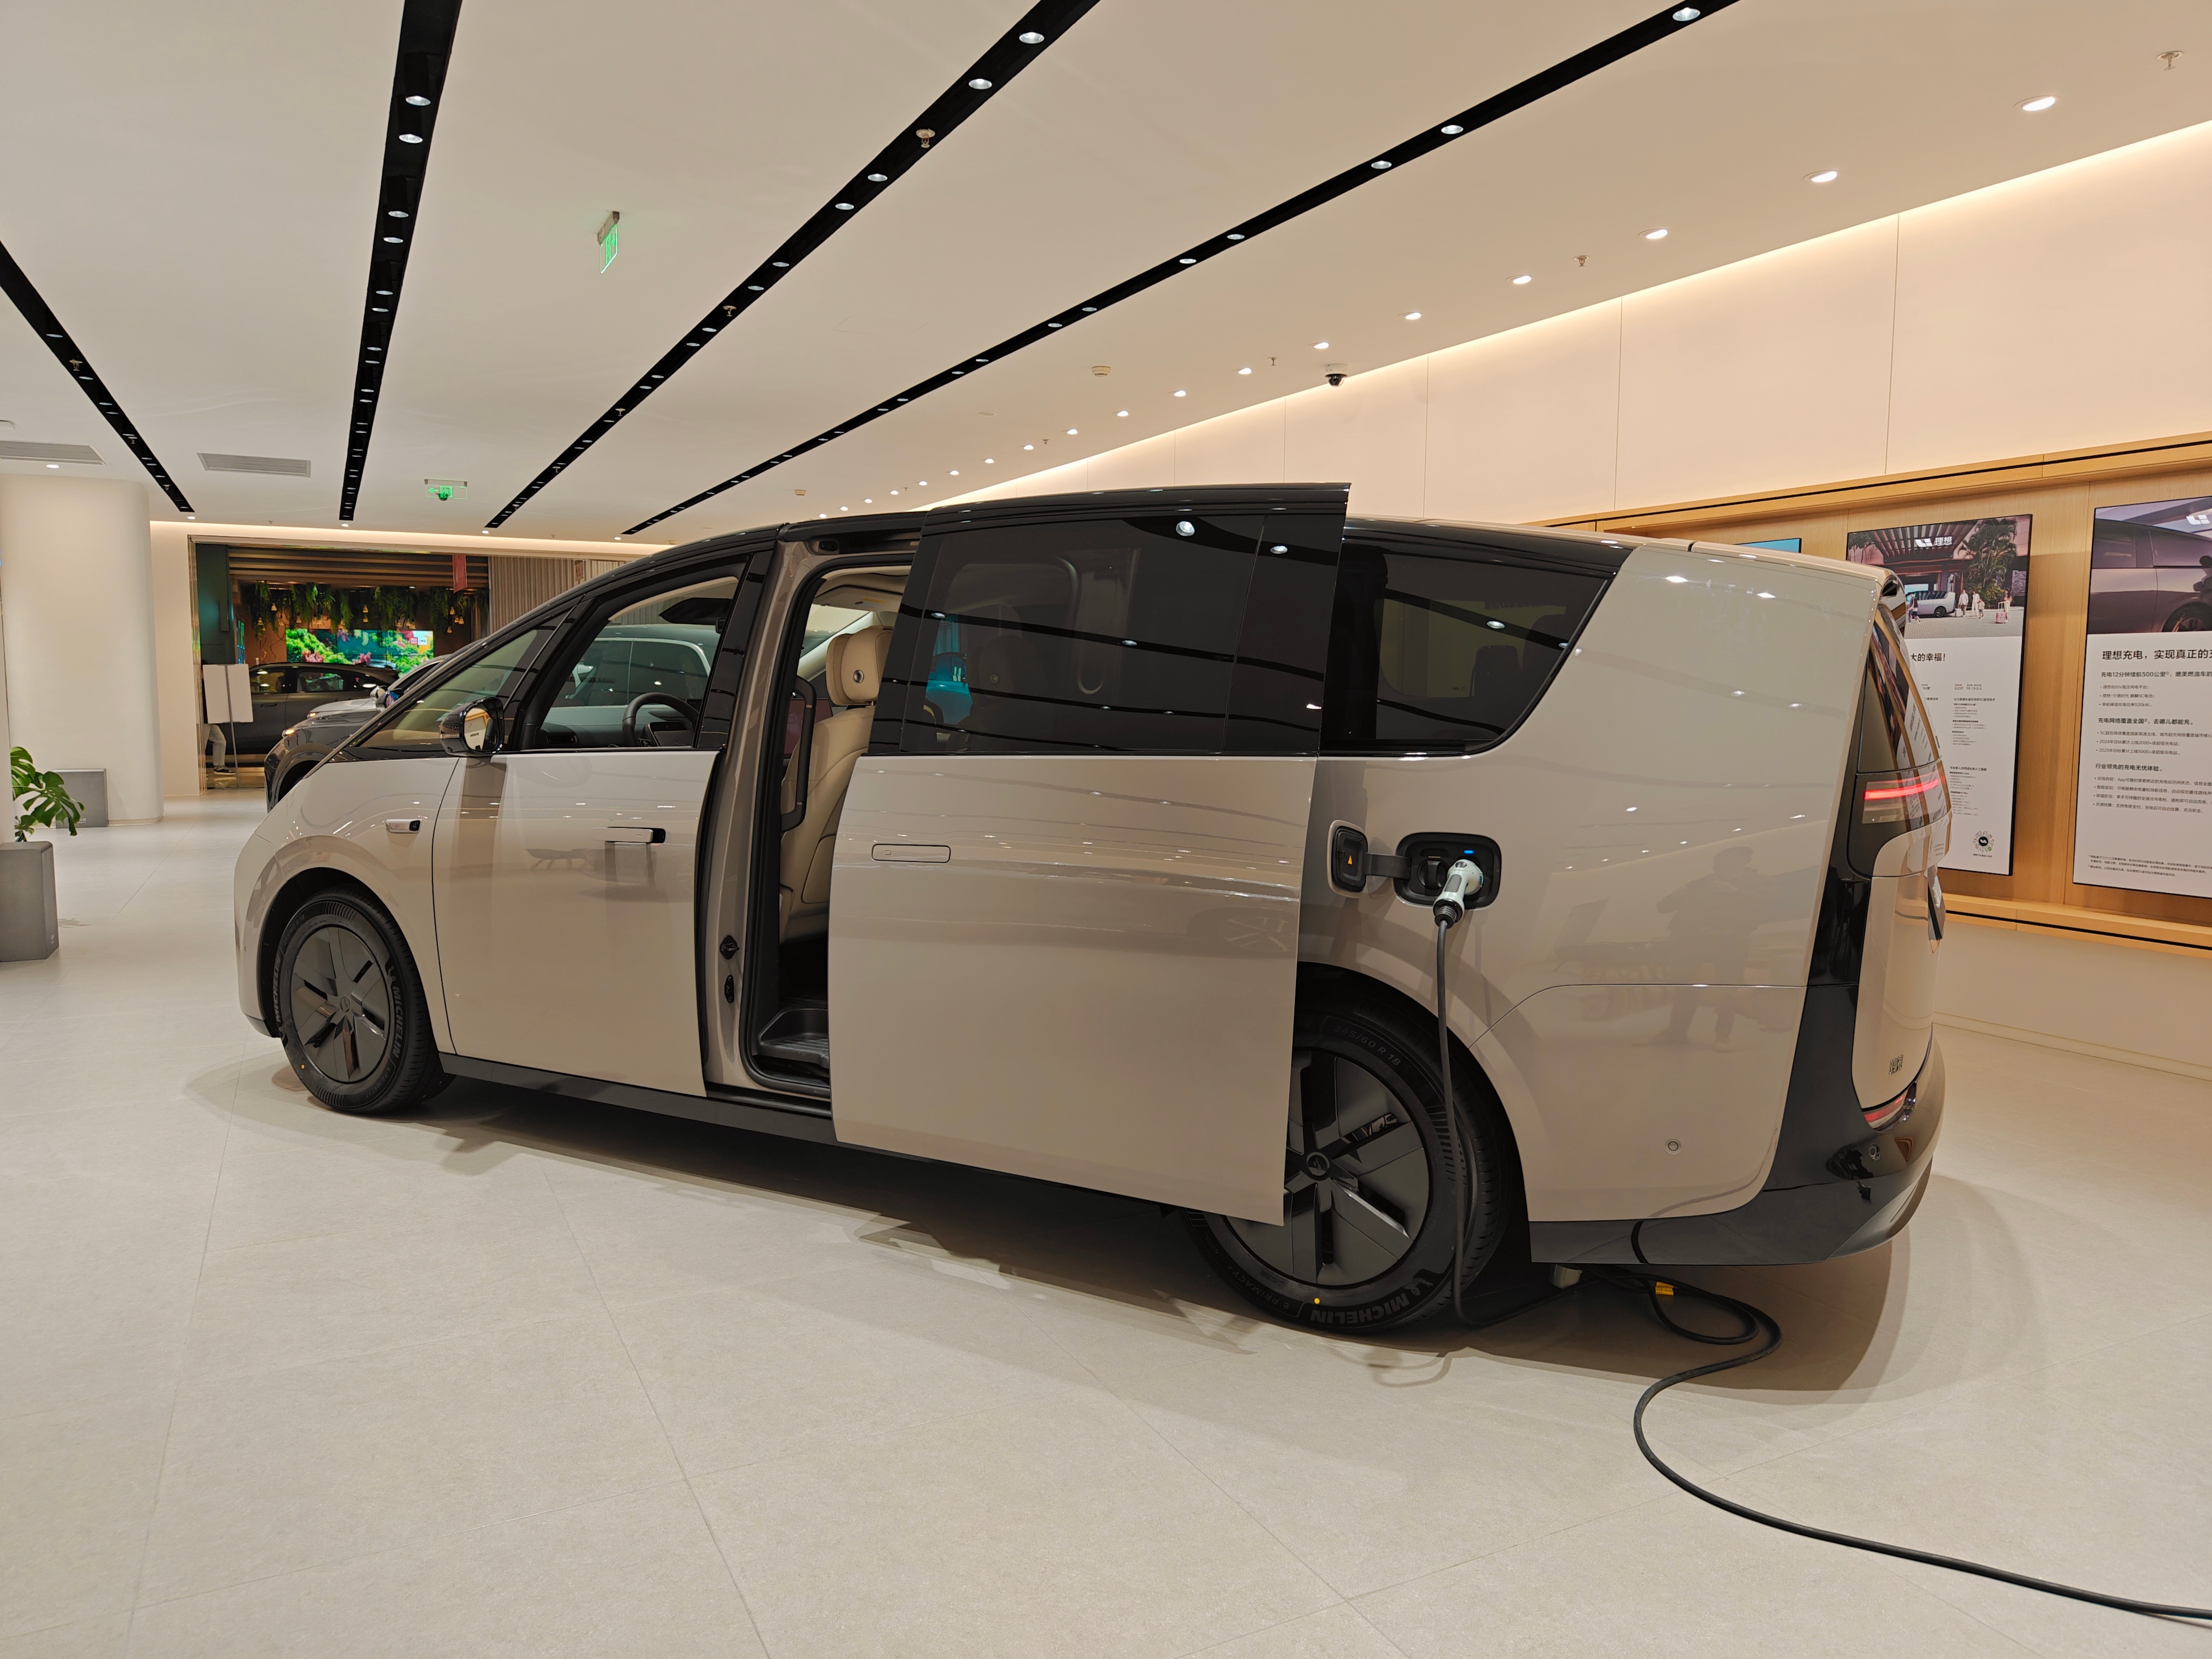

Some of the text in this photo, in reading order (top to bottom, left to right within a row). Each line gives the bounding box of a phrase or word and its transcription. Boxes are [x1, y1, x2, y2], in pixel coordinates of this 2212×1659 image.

[1934, 536, 1952, 546] 理想
[392, 986, 404, 1058] MICHELIN
[1334, 1026, 1401, 1065] 245/60 R 18
[1310, 1292, 1411, 1324] MICHELIN
